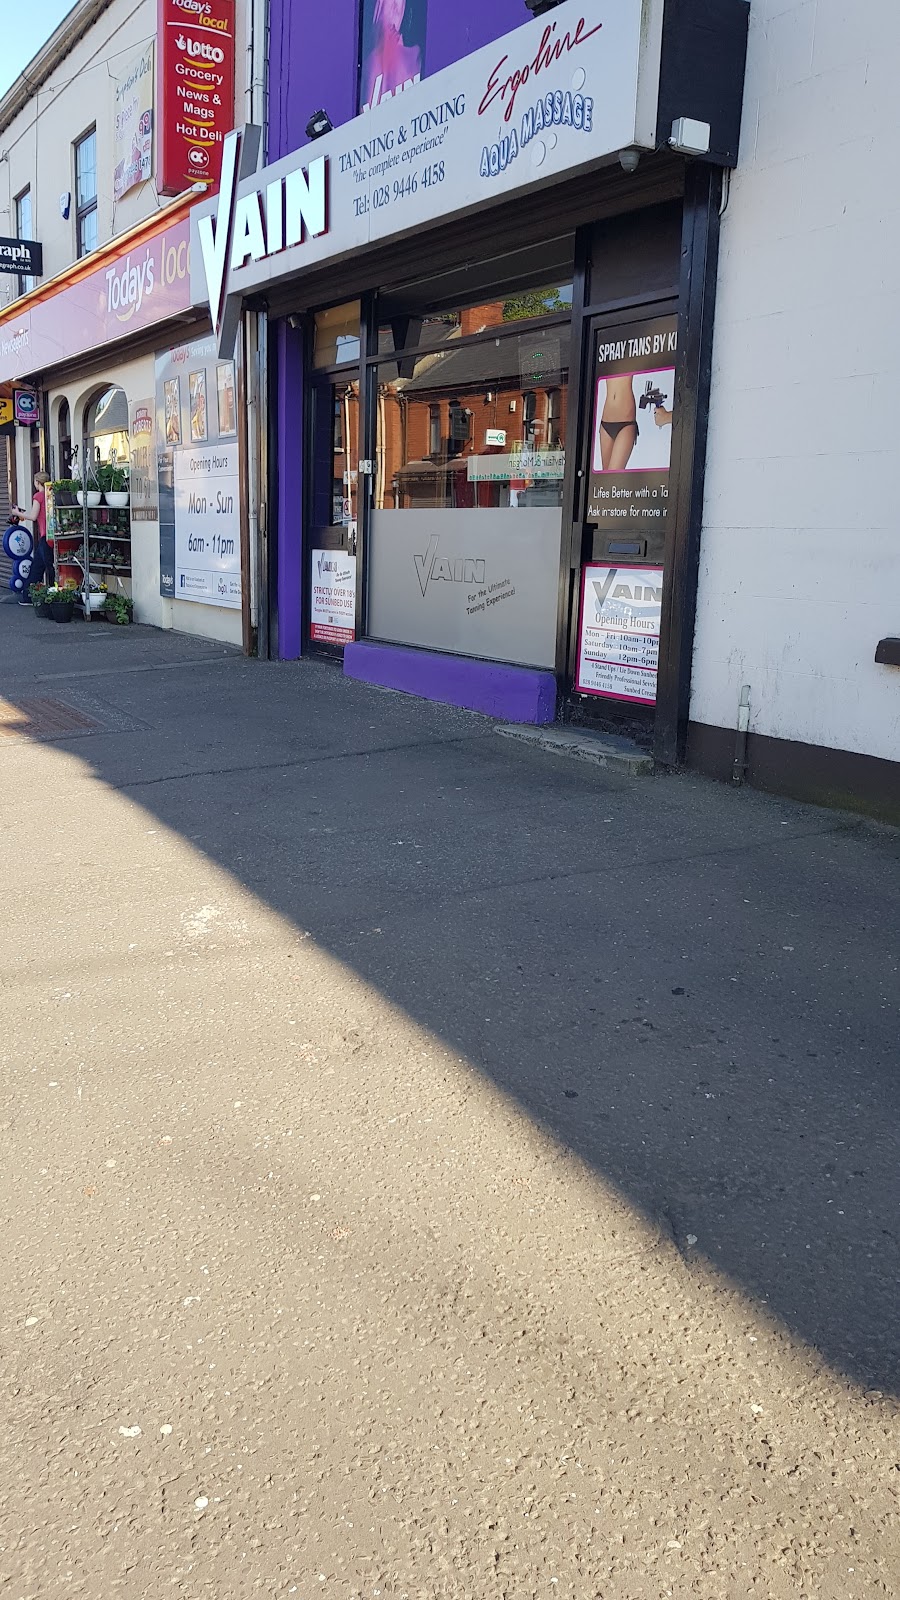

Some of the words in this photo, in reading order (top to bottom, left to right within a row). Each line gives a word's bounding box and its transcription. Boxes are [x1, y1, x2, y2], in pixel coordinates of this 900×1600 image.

[199, 13, 228, 30] local
[176, 64, 223, 85] Grocery
[478, 18, 602, 122] Ergoline
[176, 86, 209, 102] News
[212, 94, 221, 105] &
[184, 102, 214, 118] Mags
[176, 123, 197, 136] Hot
[200, 128, 222, 141] Deli
[338, 130, 394, 173] TANNING
[397, 125, 407, 145] &
[411, 94, 466, 138] TONING
[480, 129, 518, 177] AQUA
[520, 90, 593, 148] MASSAGE
[369, 153, 400, 176] complete
[353, 194, 370, 217] Tel:
[373, 185, 390, 209] 028
[393, 172, 418, 202] 9446
[421, 161, 445, 188] 4158
[198, 132, 328, 334] VAIN
[105, 248, 154, 312] Today's
[160, 238, 190, 286] loc
[598, 340, 626, 362] SPRAY
[628, 336, 651, 358] TANS
[652, 333, 666, 354] BY
[190, 457, 211, 473] Opening
[212, 456, 228, 469] Hours
[593, 486, 610, 499] Lifes
[611, 486, 632, 498] Better
[635, 486, 650, 498] with
[652, 490, 657, 498] a
[188, 492, 206, 514] Mon
[216, 491, 233, 514] Sun
[588, 505, 600, 517] Ask
[602, 507, 627, 517] in-store
[630, 505, 640, 517] for
[642, 508, 660, 517] more
[188, 533, 204, 552] 6am
[212, 534, 234, 558] 11pm
[413, 534, 485, 597] VAIN
[314, 586, 333, 596] STRICTLY
[334, 588, 346, 597] OVER
[468, 594, 476, 603] For
[478, 589, 487, 599] the
[488, 579, 510, 593] Ultimate
[592, 569, 662, 607] VAIN
[316, 596, 324, 605] FOR
[325, 598, 343, 608] SUNBED
[344, 600, 352, 608] USE
[466, 602, 485, 615] Tanning
[595, 612, 628, 629] Opening
[630, 617, 655, 629] Hours
[584, 649, 607, 659] Sunday
[619, 654, 657, 666] 12pm-6pm
[619, 644, 658, 656] 10am-7pm
[596, 672, 613, 682] Friendly
[614, 675, 642, 685] Professional
[624, 686, 640, 694] Sunbed
